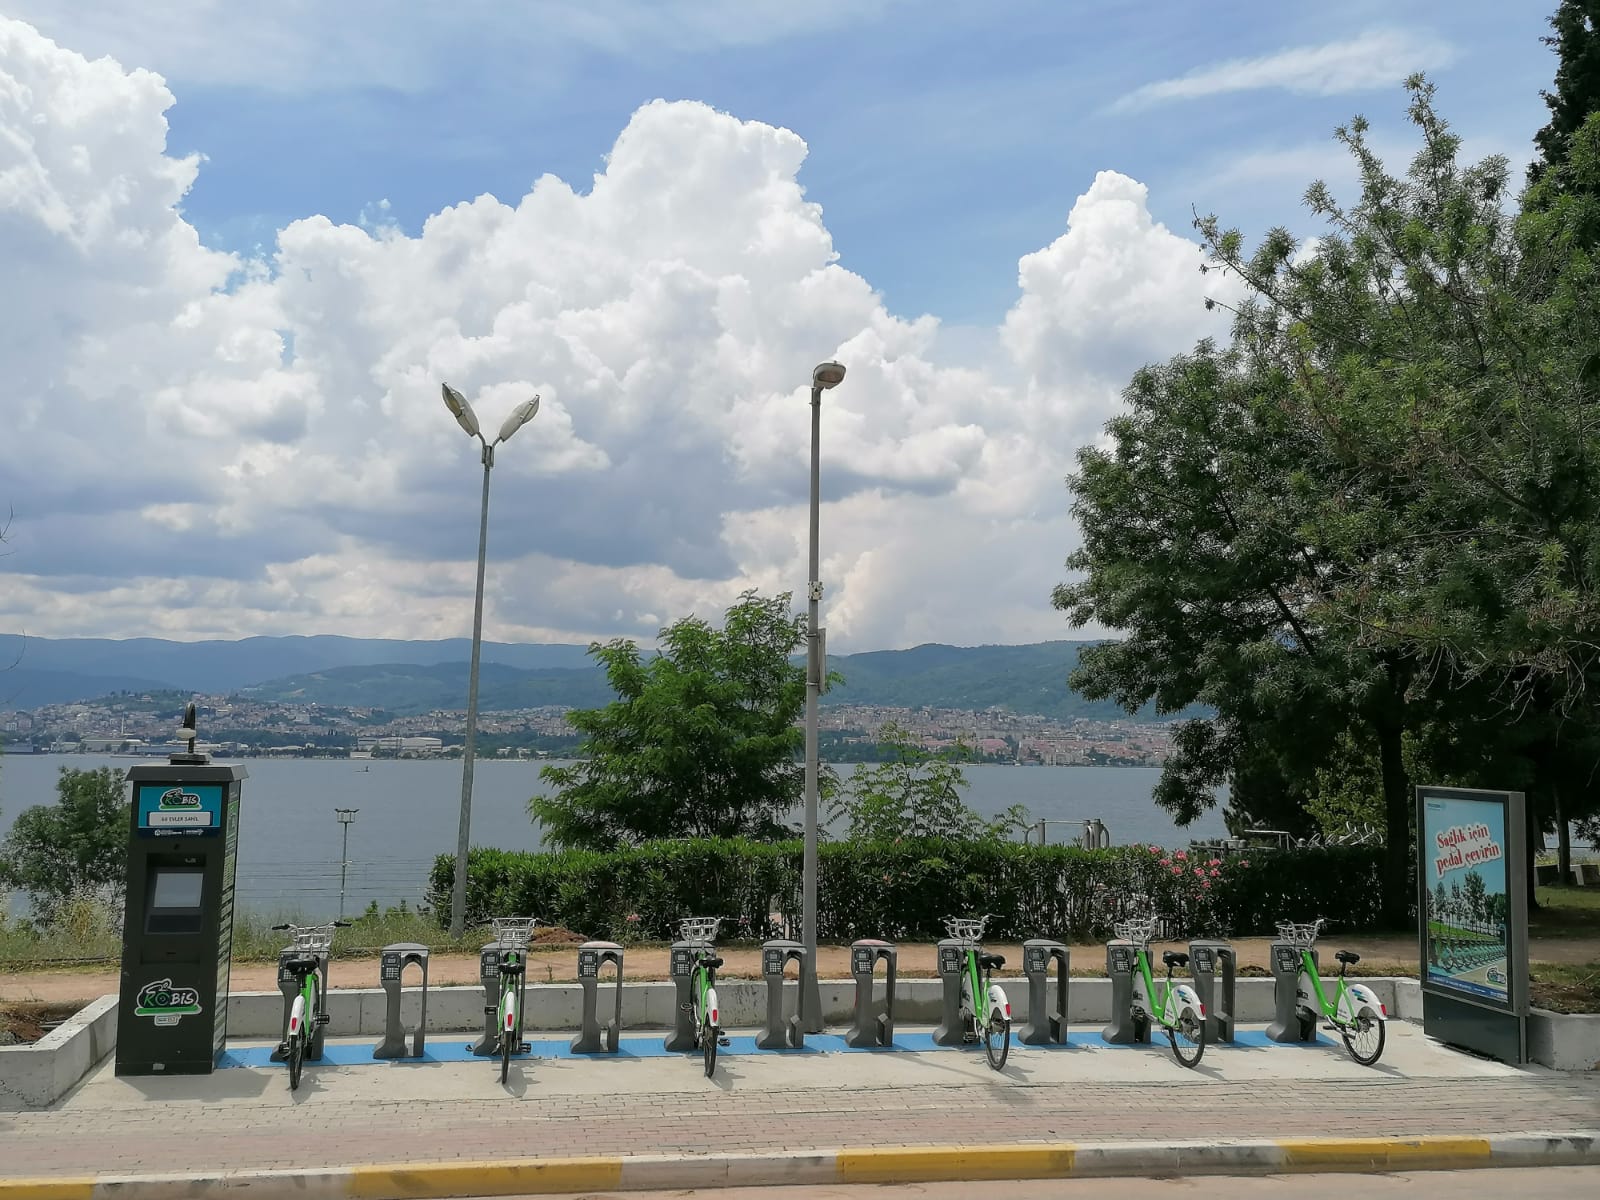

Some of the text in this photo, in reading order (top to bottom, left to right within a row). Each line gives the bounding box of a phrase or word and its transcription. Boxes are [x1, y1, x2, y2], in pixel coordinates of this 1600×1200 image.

[1437, 825, 1488, 851] Sağlık için
[1436, 843, 1499, 875] pedal çevirin
